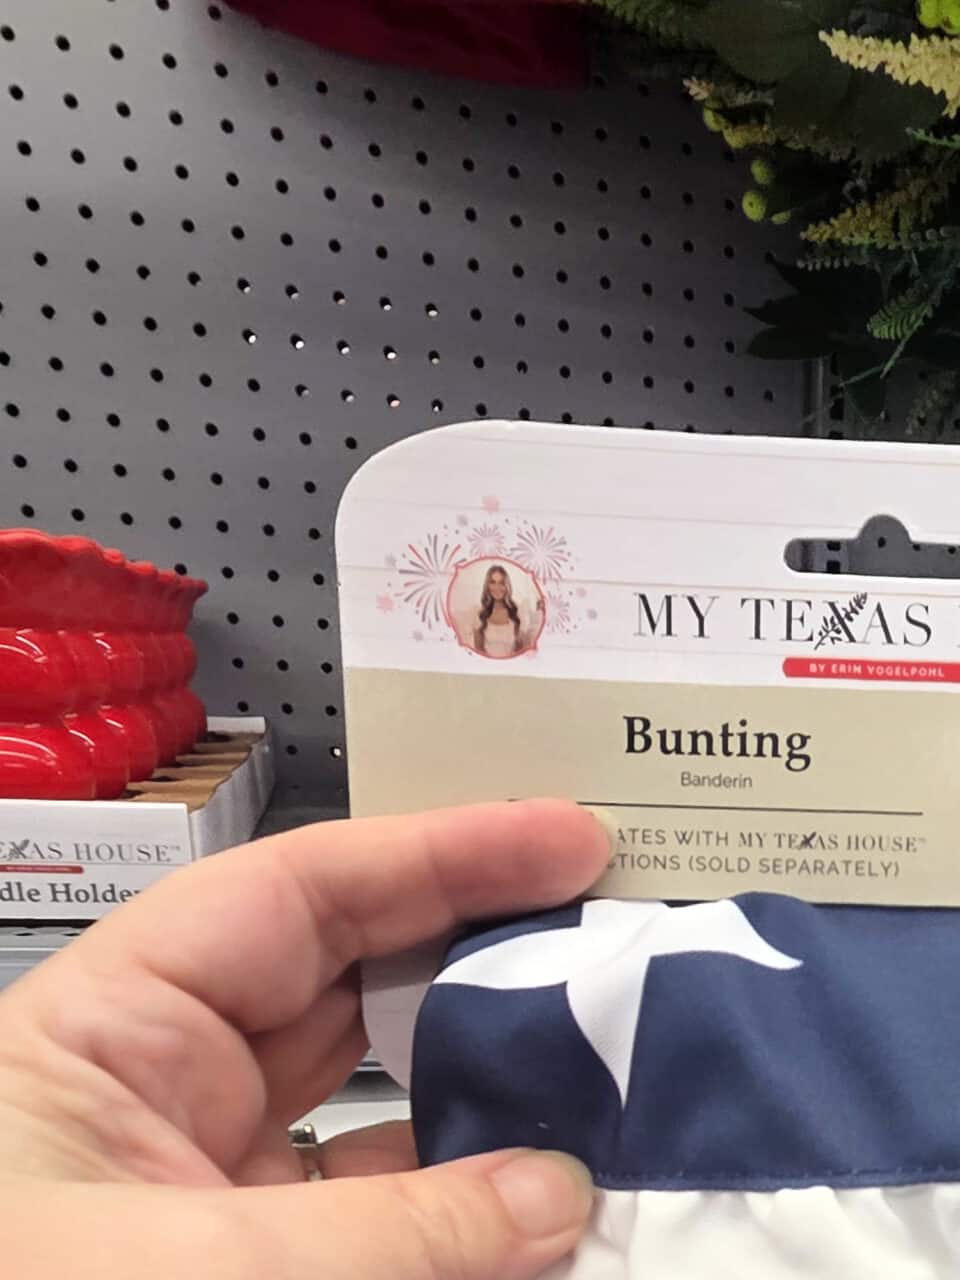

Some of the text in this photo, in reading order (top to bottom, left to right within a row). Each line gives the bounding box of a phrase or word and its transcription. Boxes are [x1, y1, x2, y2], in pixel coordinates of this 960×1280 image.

[633, 592, 720, 639] MY
[740, 593, 932, 650] TEXAS
[809, 663, 945, 679] BY ERIN VOGELPOHL
[623, 715, 812, 772] Bunting
[680, 771, 753, 789] Banderin
[674, 830, 729, 847] WITH
[738, 832, 766, 849] MY
[776, 831, 839, 851] TEXAS
[688, 856, 750, 874] (SOLD
[758, 859, 901, 879] SEPARATELY)
